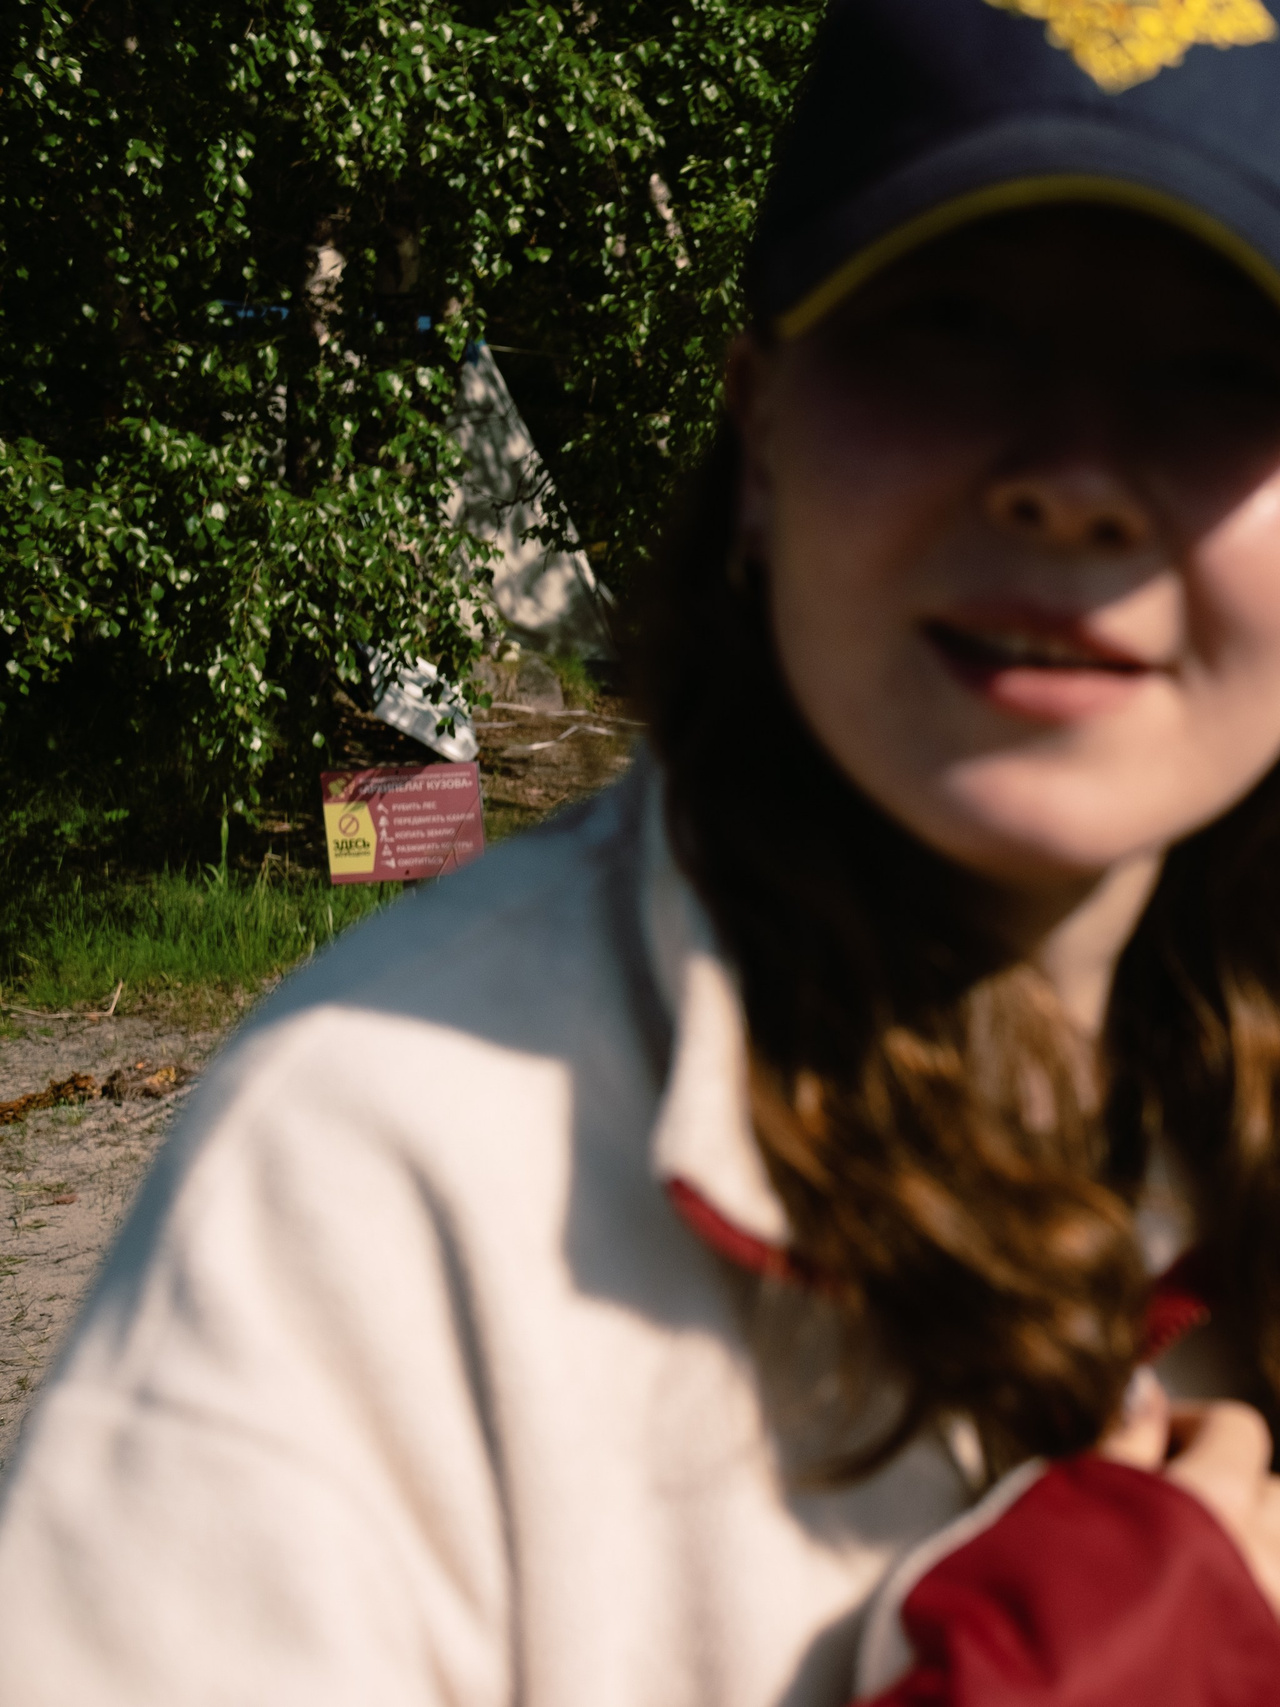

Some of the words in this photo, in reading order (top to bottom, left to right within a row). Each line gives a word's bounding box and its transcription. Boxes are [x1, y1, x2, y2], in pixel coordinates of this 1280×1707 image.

[426, 777, 473, 791] КУЗОВА»
[391, 802, 422, 812] РУБИТЬ
[422, 800, 437, 810] ЛЕС
[393, 814, 445, 826] ПЕРЕДВИГАТЬ
[394, 829, 426, 840] КОПАТЬ
[426, 827, 455, 838] ЗЕМЛЮ
[333, 838, 370, 852] ЗДЕСЬ
[396, 843, 440, 854] РАЗЖИГАТЬ
[397, 855, 444, 868] ОХОТИТЬСЯ
